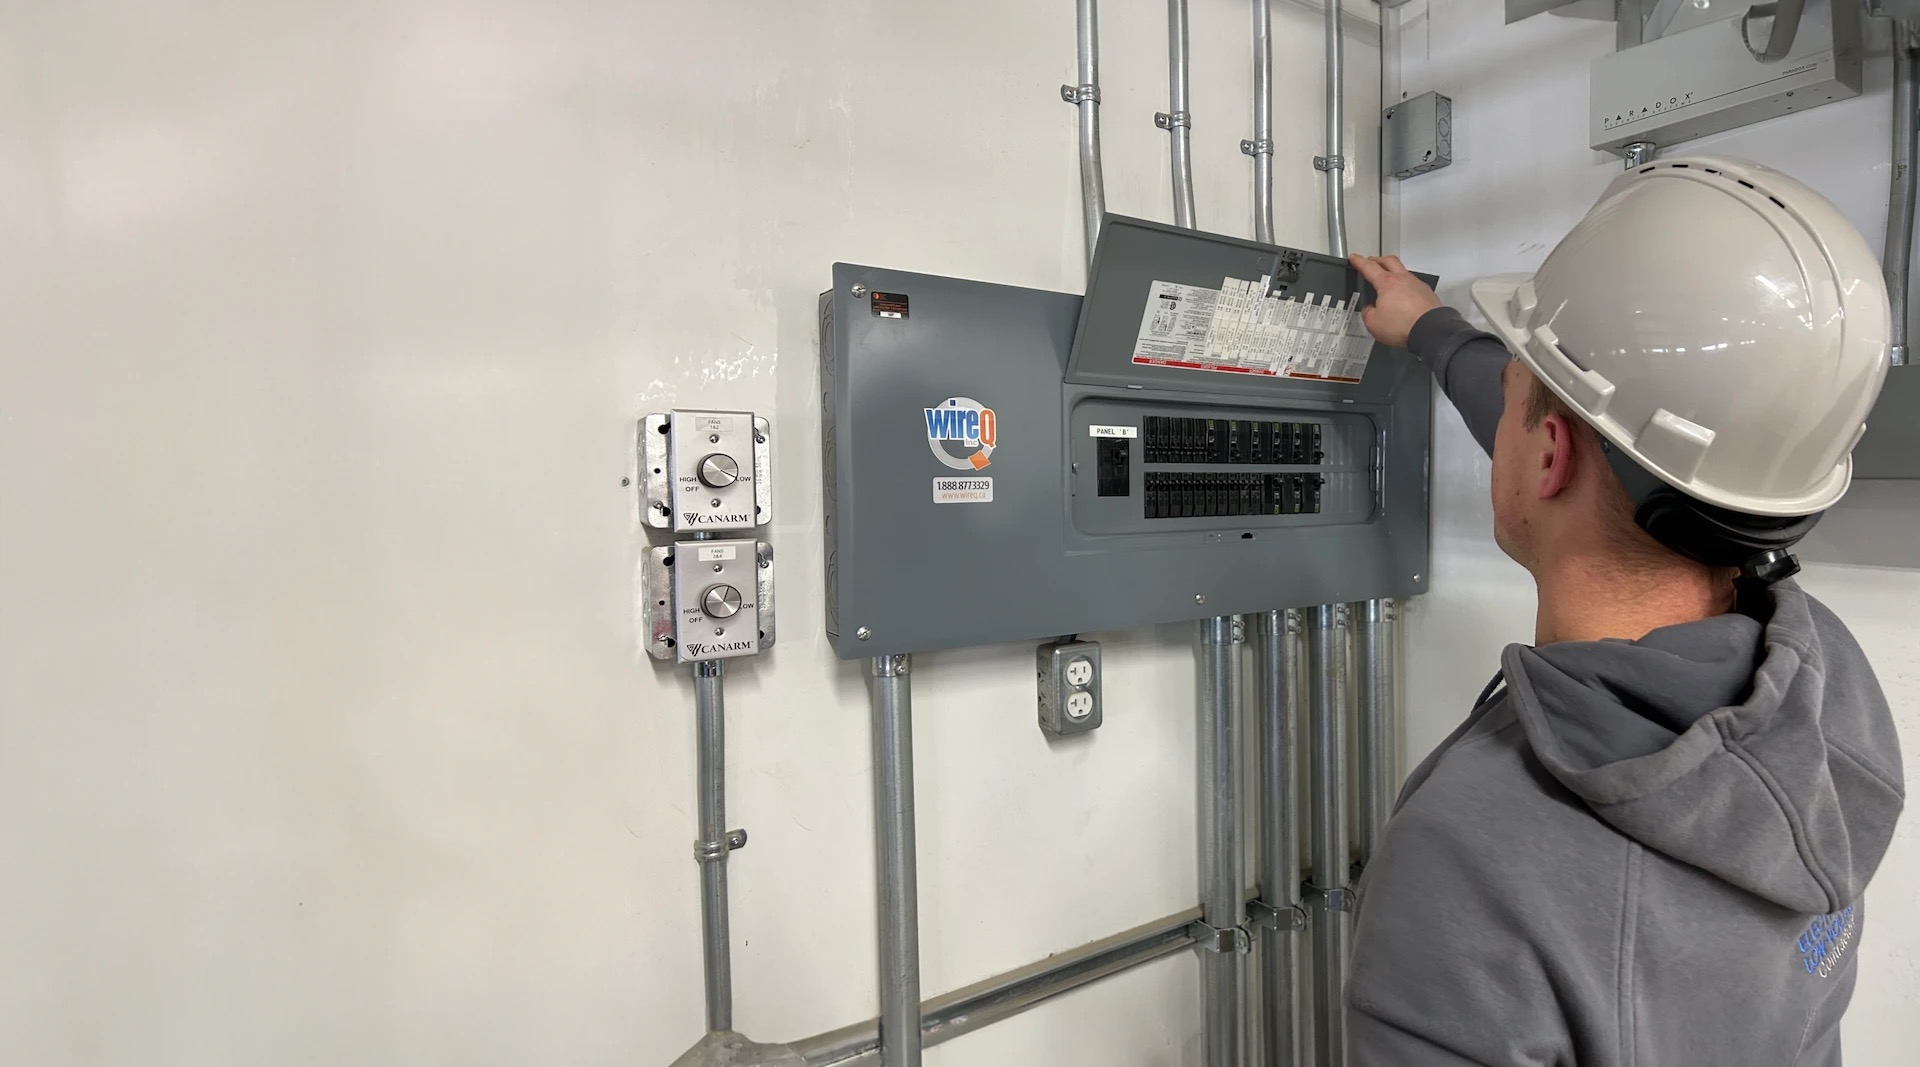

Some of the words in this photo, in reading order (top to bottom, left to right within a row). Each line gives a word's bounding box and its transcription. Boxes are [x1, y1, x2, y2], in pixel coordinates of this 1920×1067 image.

[1096, 427, 1115, 435] PANEL
[698, 514, 748, 523] CANARM
[701, 641, 751, 654] CANARM
